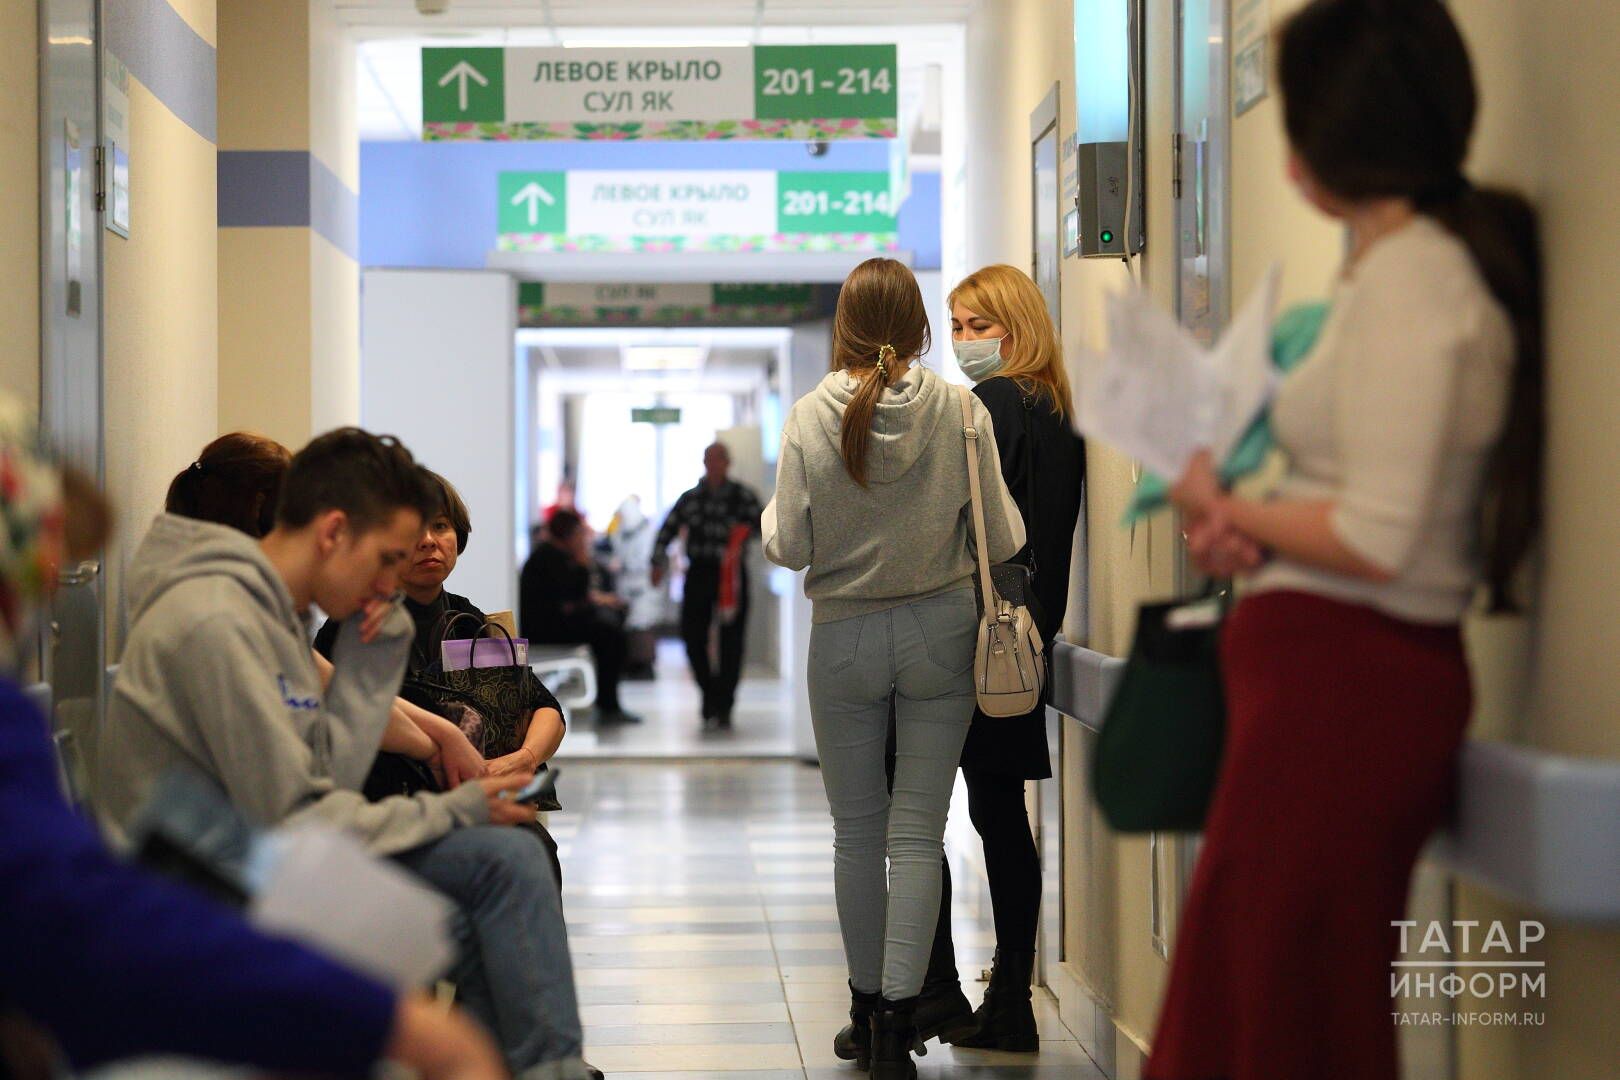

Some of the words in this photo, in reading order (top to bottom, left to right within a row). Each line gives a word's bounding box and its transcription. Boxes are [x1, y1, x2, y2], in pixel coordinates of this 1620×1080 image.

[534, 61, 618, 82] ЛЕВОЕ
[627, 59, 722, 81] КРЫЛО
[583, 91, 633, 112] СУЛ
[642, 90, 673, 112] ЯК
[592, 183, 661, 201] ЛЕВОЕ
[669, 183, 750, 201] КРЫЛО
[632, 208, 675, 227] СУЛ
